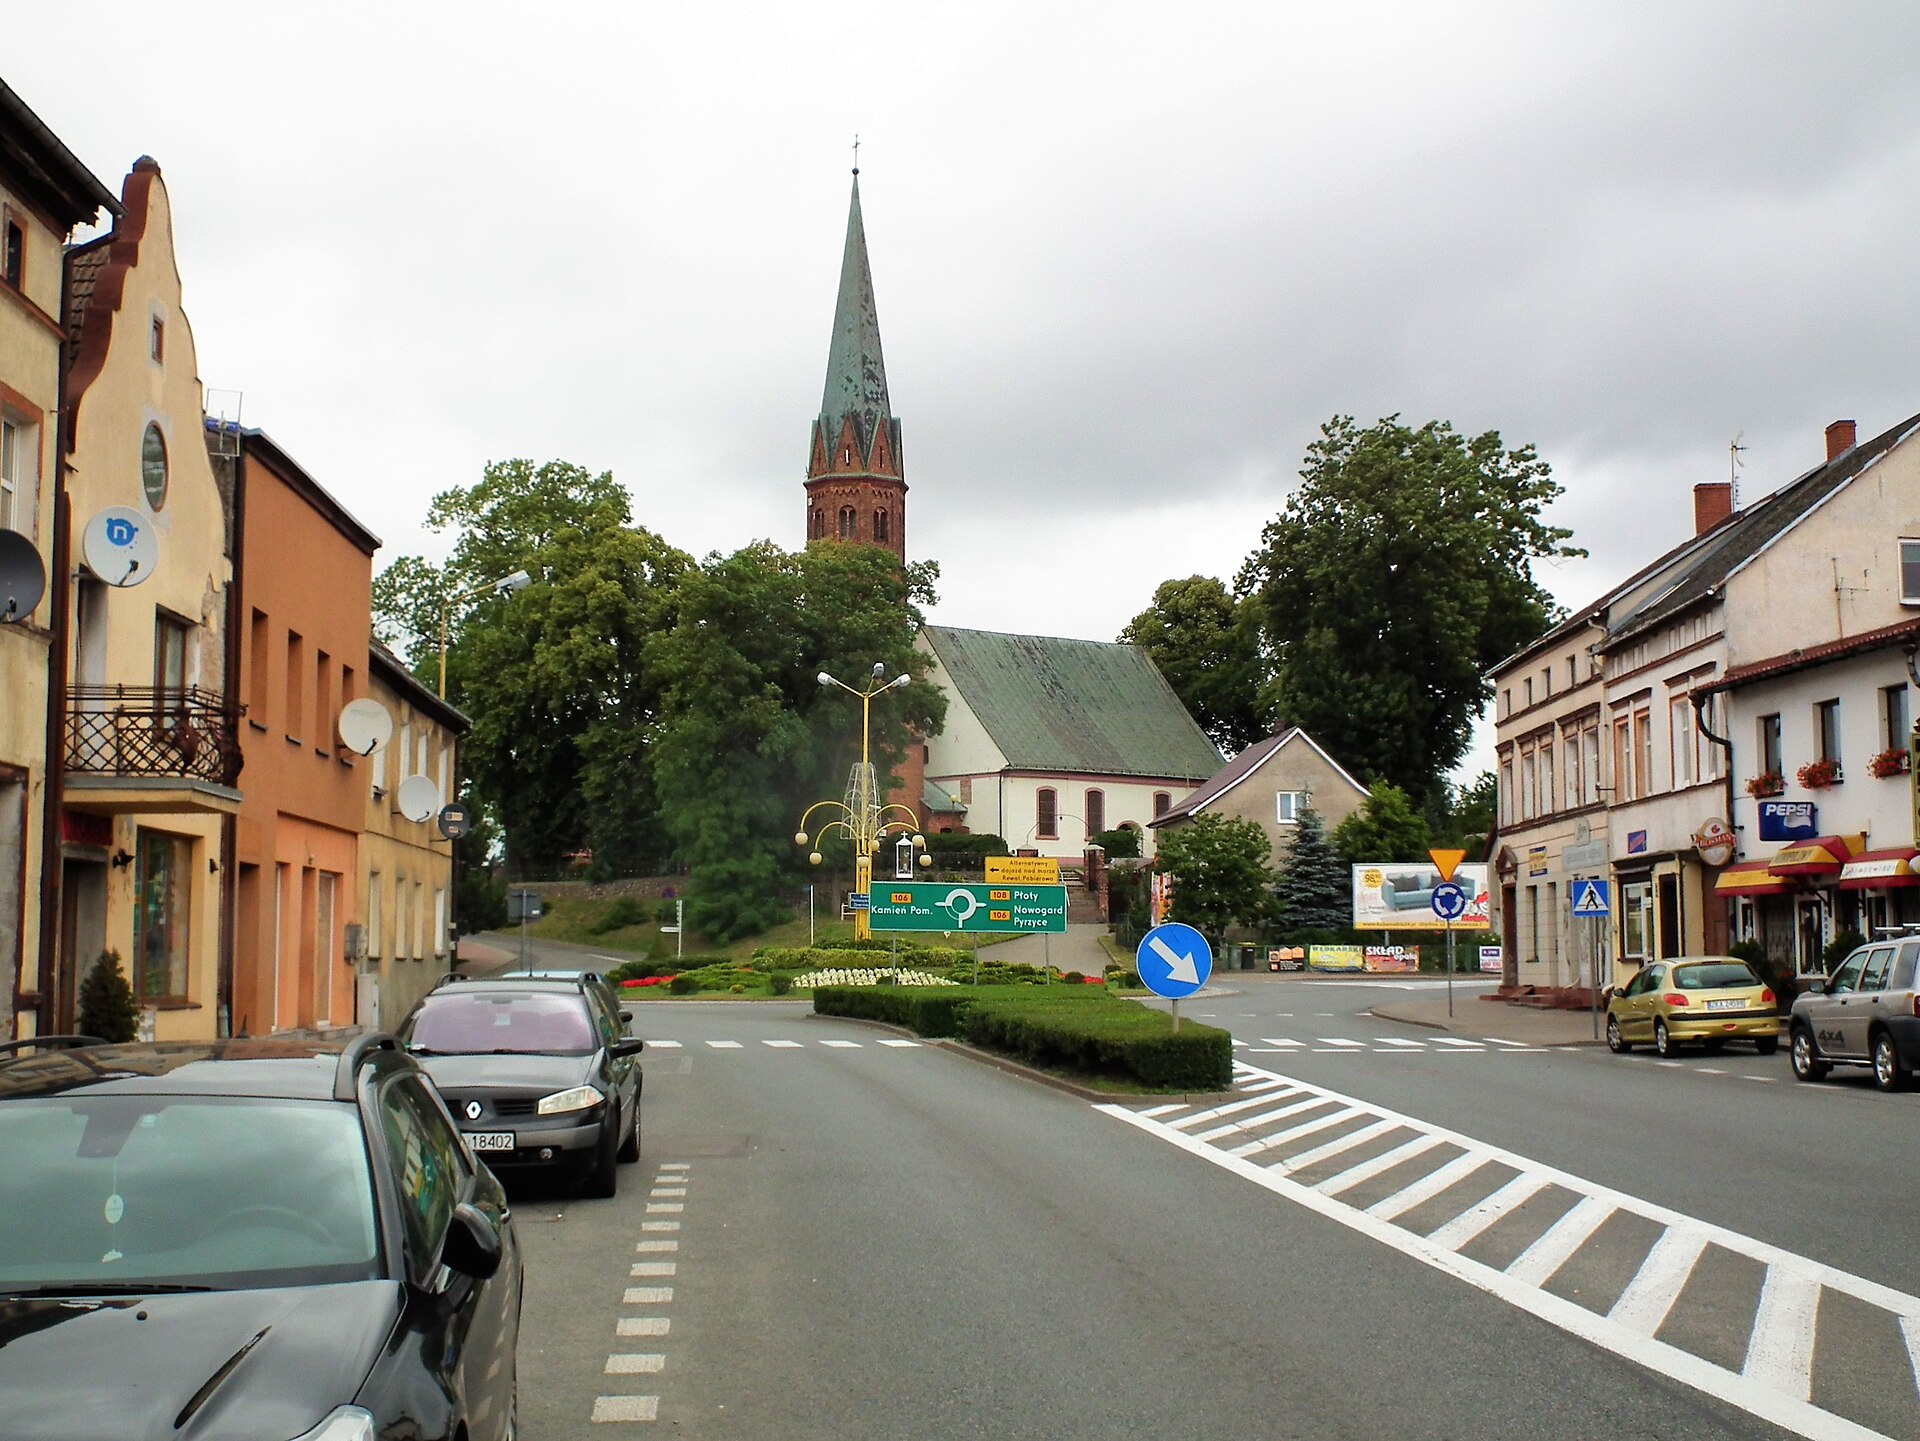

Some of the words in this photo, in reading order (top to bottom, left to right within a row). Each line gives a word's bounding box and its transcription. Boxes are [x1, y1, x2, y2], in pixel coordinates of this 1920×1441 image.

[1765, 803, 1812, 816] PEPSI
[894, 894, 908, 902] 106
[993, 891, 1007, 899] 108
[1014, 891, 1038, 902] Płoty
[871, 905, 907, 914] Kamień
[910, 906, 933, 915] Pom.
[1014, 905, 1063, 917] Nowogard
[1014, 917, 1048, 928] Pyrzyce
[472, 1135, 513, 1148] 18402
